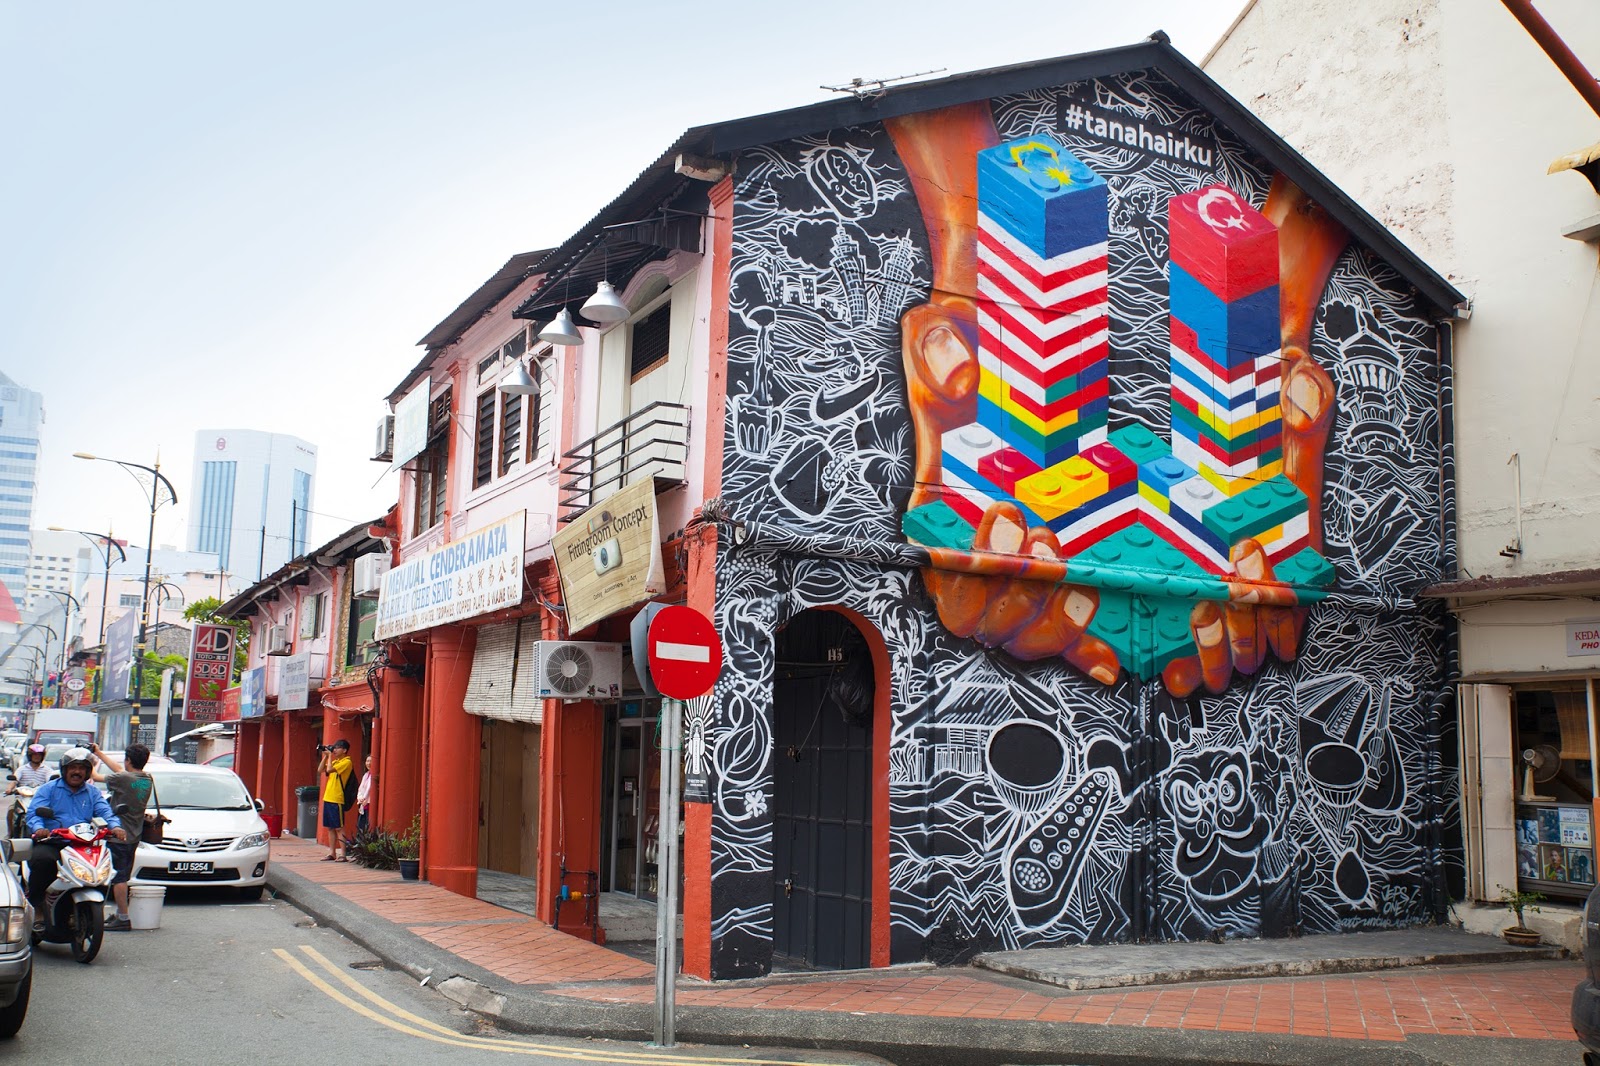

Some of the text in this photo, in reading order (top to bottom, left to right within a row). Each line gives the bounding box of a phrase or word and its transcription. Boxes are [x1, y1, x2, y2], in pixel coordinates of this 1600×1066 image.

[1065, 104, 1212, 167] #tanahairku
[567, 503, 648, 562] Fittingroom Concept
[388, 524, 508, 597] MENJUAL CENDERAMATA
[411, 585, 431, 611] CHEE
[431, 578, 453, 605] SENG
[197, 628, 232, 652] 4D
[195, 663, 227, 675] 5D 6D
[174, 863, 209, 871] JLU 5254
